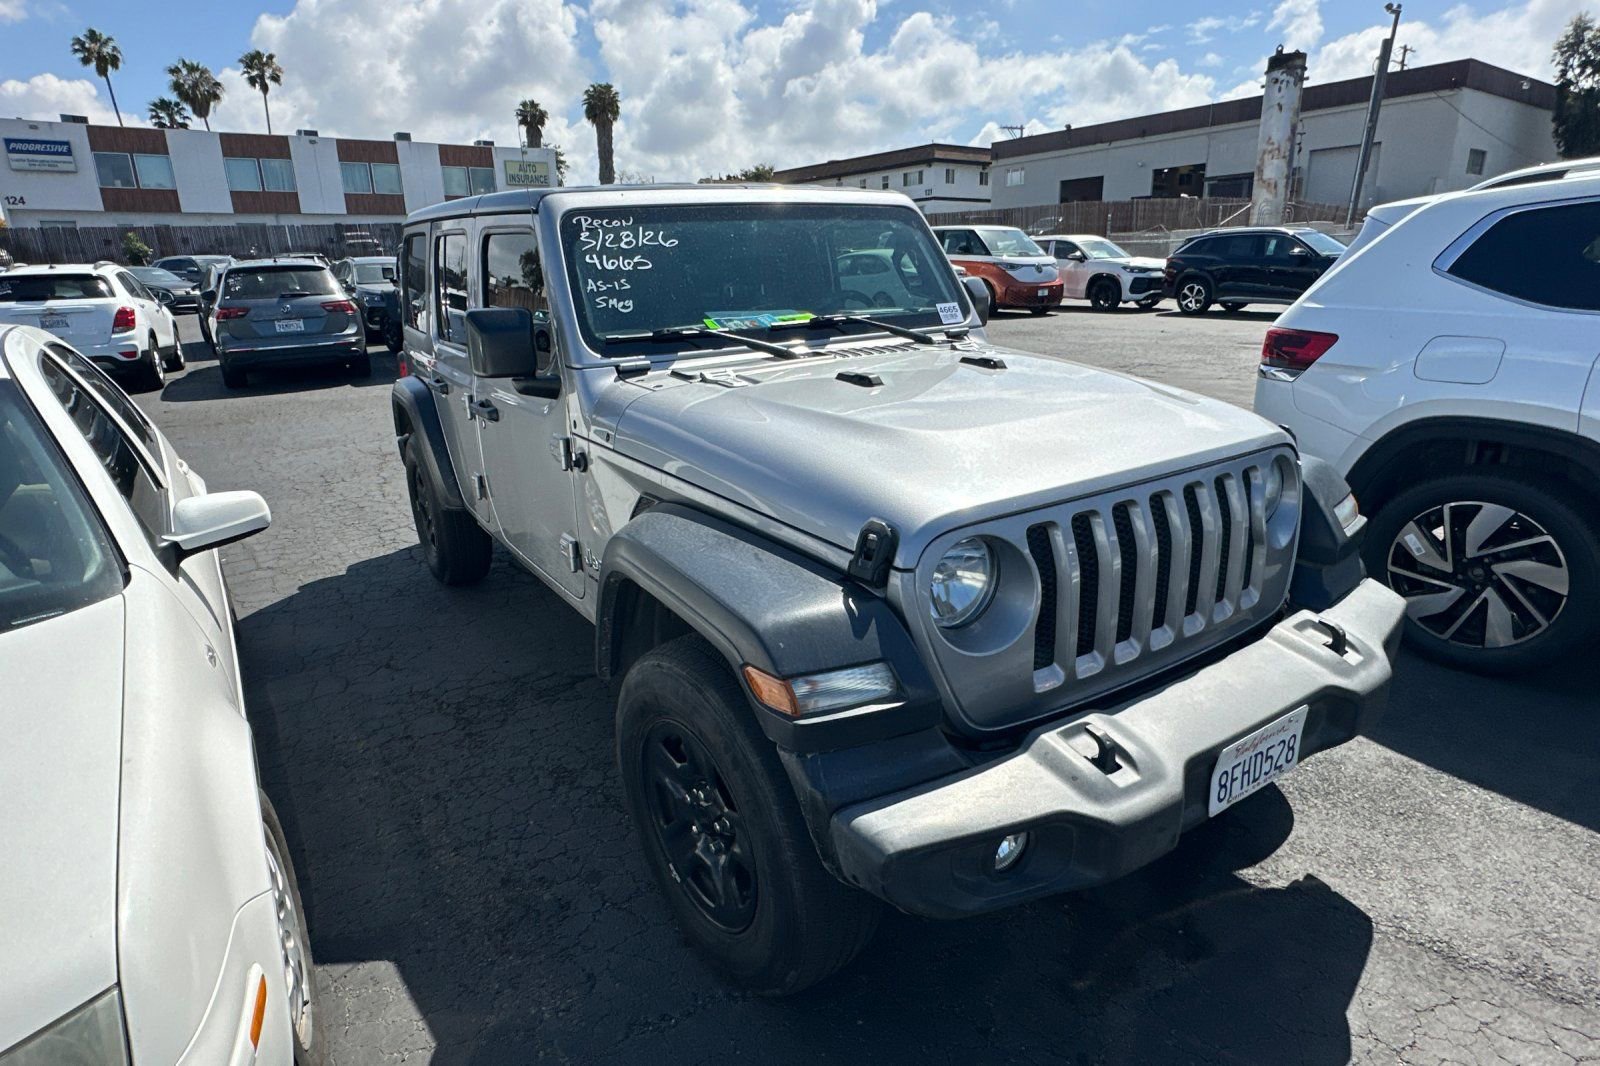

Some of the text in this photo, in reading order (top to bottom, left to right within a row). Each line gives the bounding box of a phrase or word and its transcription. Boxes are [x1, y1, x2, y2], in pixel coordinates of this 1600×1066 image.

[9, 142, 69, 153] PROGRESSIVE
[518, 163, 537, 173] AUTO
[508, 173, 549, 184] INSURANCE
[4, 195, 26, 205] 124
[585, 254, 653, 270] 4665
[939, 305, 959, 314] 4665
[1217, 734, 1297, 803] 8FHD528
